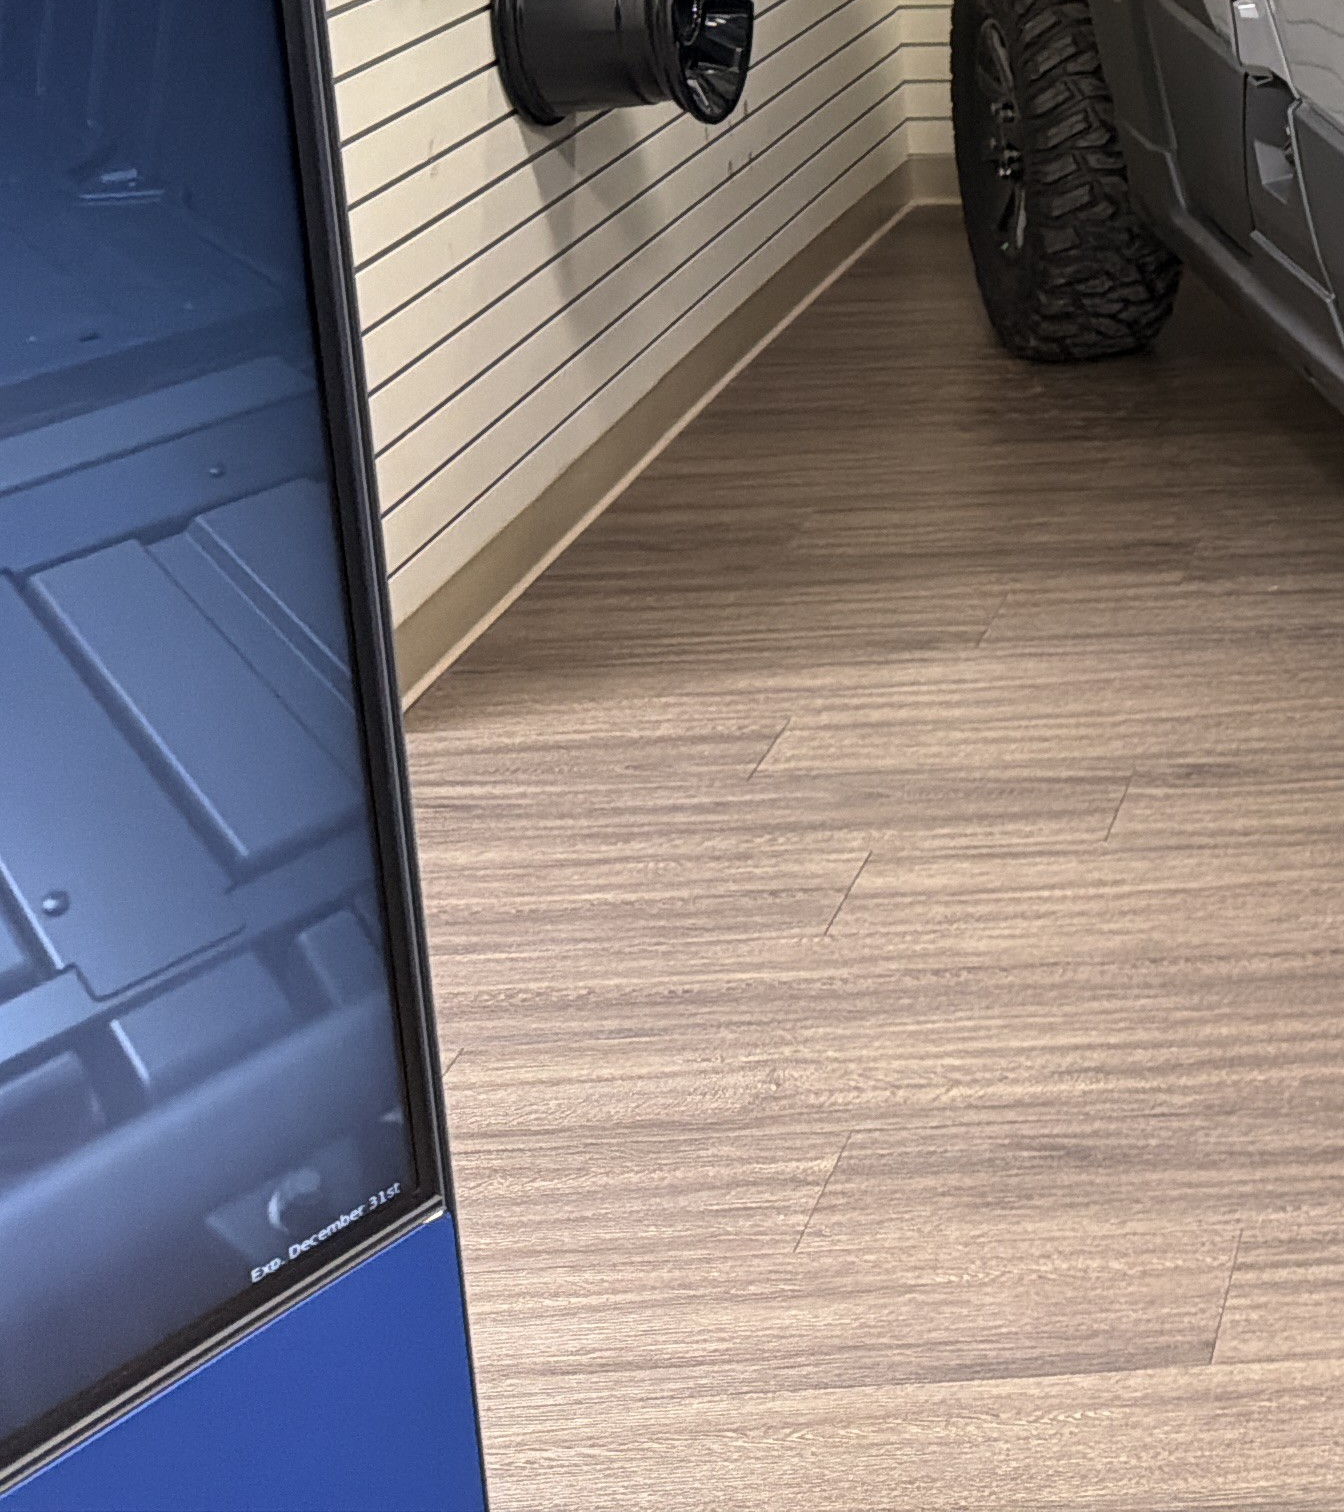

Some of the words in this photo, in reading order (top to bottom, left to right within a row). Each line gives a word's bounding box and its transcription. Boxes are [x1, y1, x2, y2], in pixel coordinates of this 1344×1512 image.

[250, 1257, 286, 1283] Exp.
[288, 1204, 366, 1260] December
[368, 1182, 401, 1211] 31st
